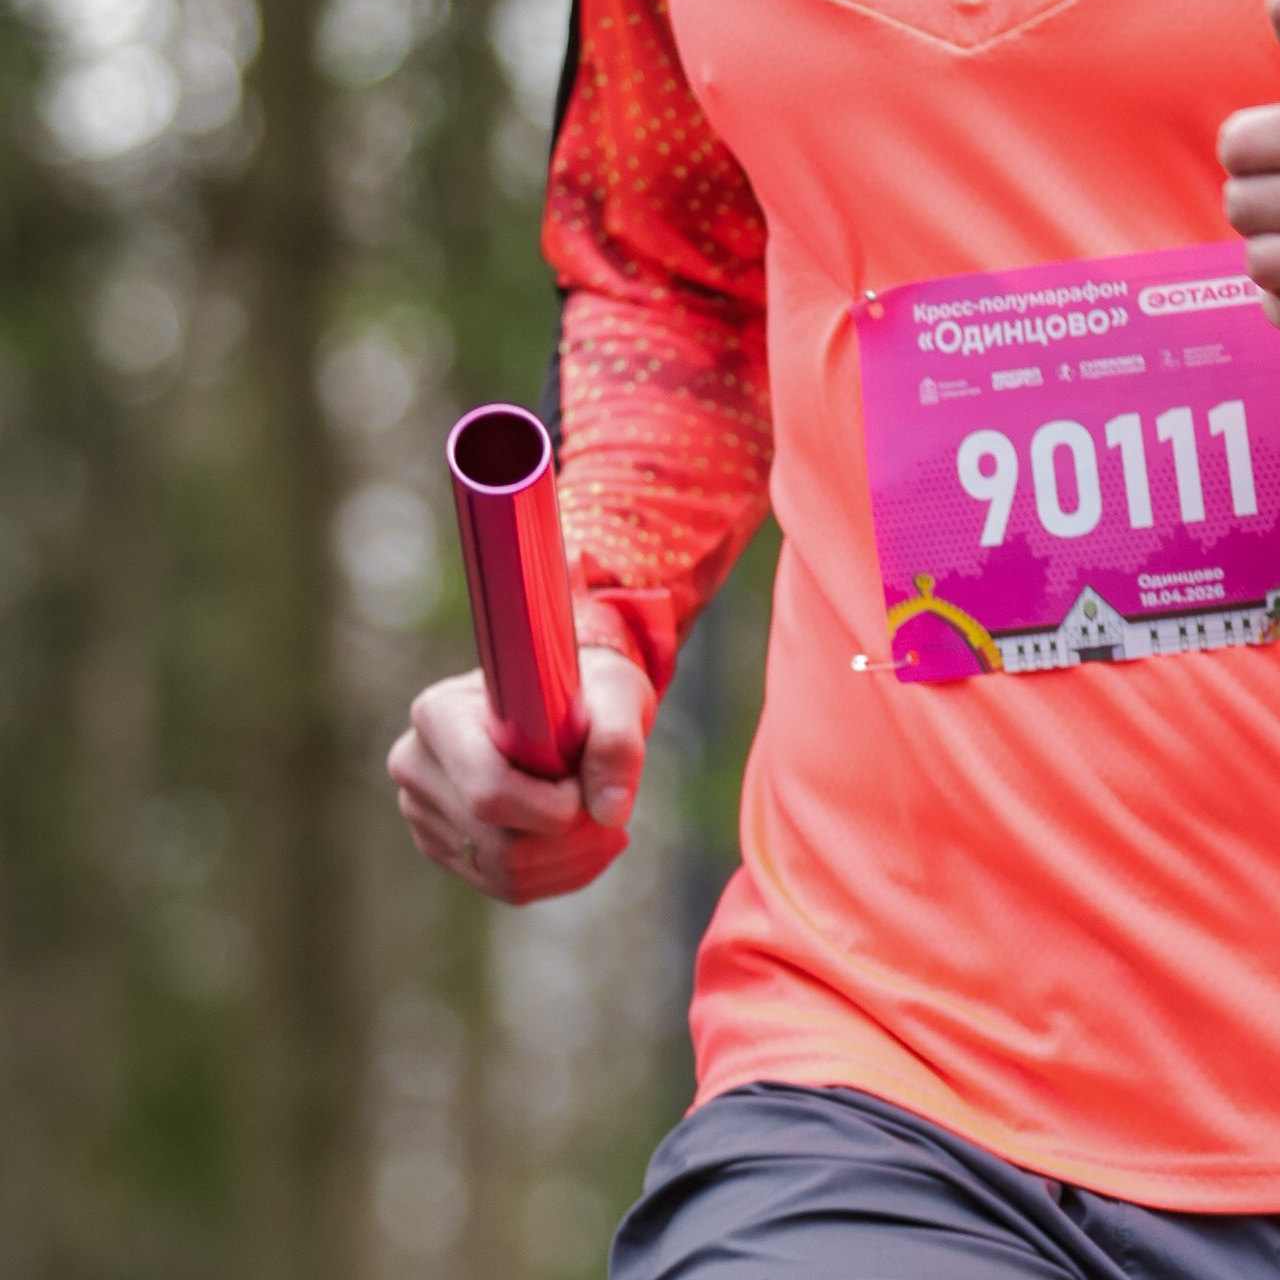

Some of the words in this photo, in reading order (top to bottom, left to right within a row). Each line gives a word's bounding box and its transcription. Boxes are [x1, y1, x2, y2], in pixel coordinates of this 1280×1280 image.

[913, 279, 1129, 324] Кросс-полумарафон
[1148, 280, 1258, 308] ЭСТАФЕ
[956, 399, 1258, 548] 90111
[1138, 567, 1225, 590] Одинцово
[1140, 582, 1225, 607] 18.04.2026
